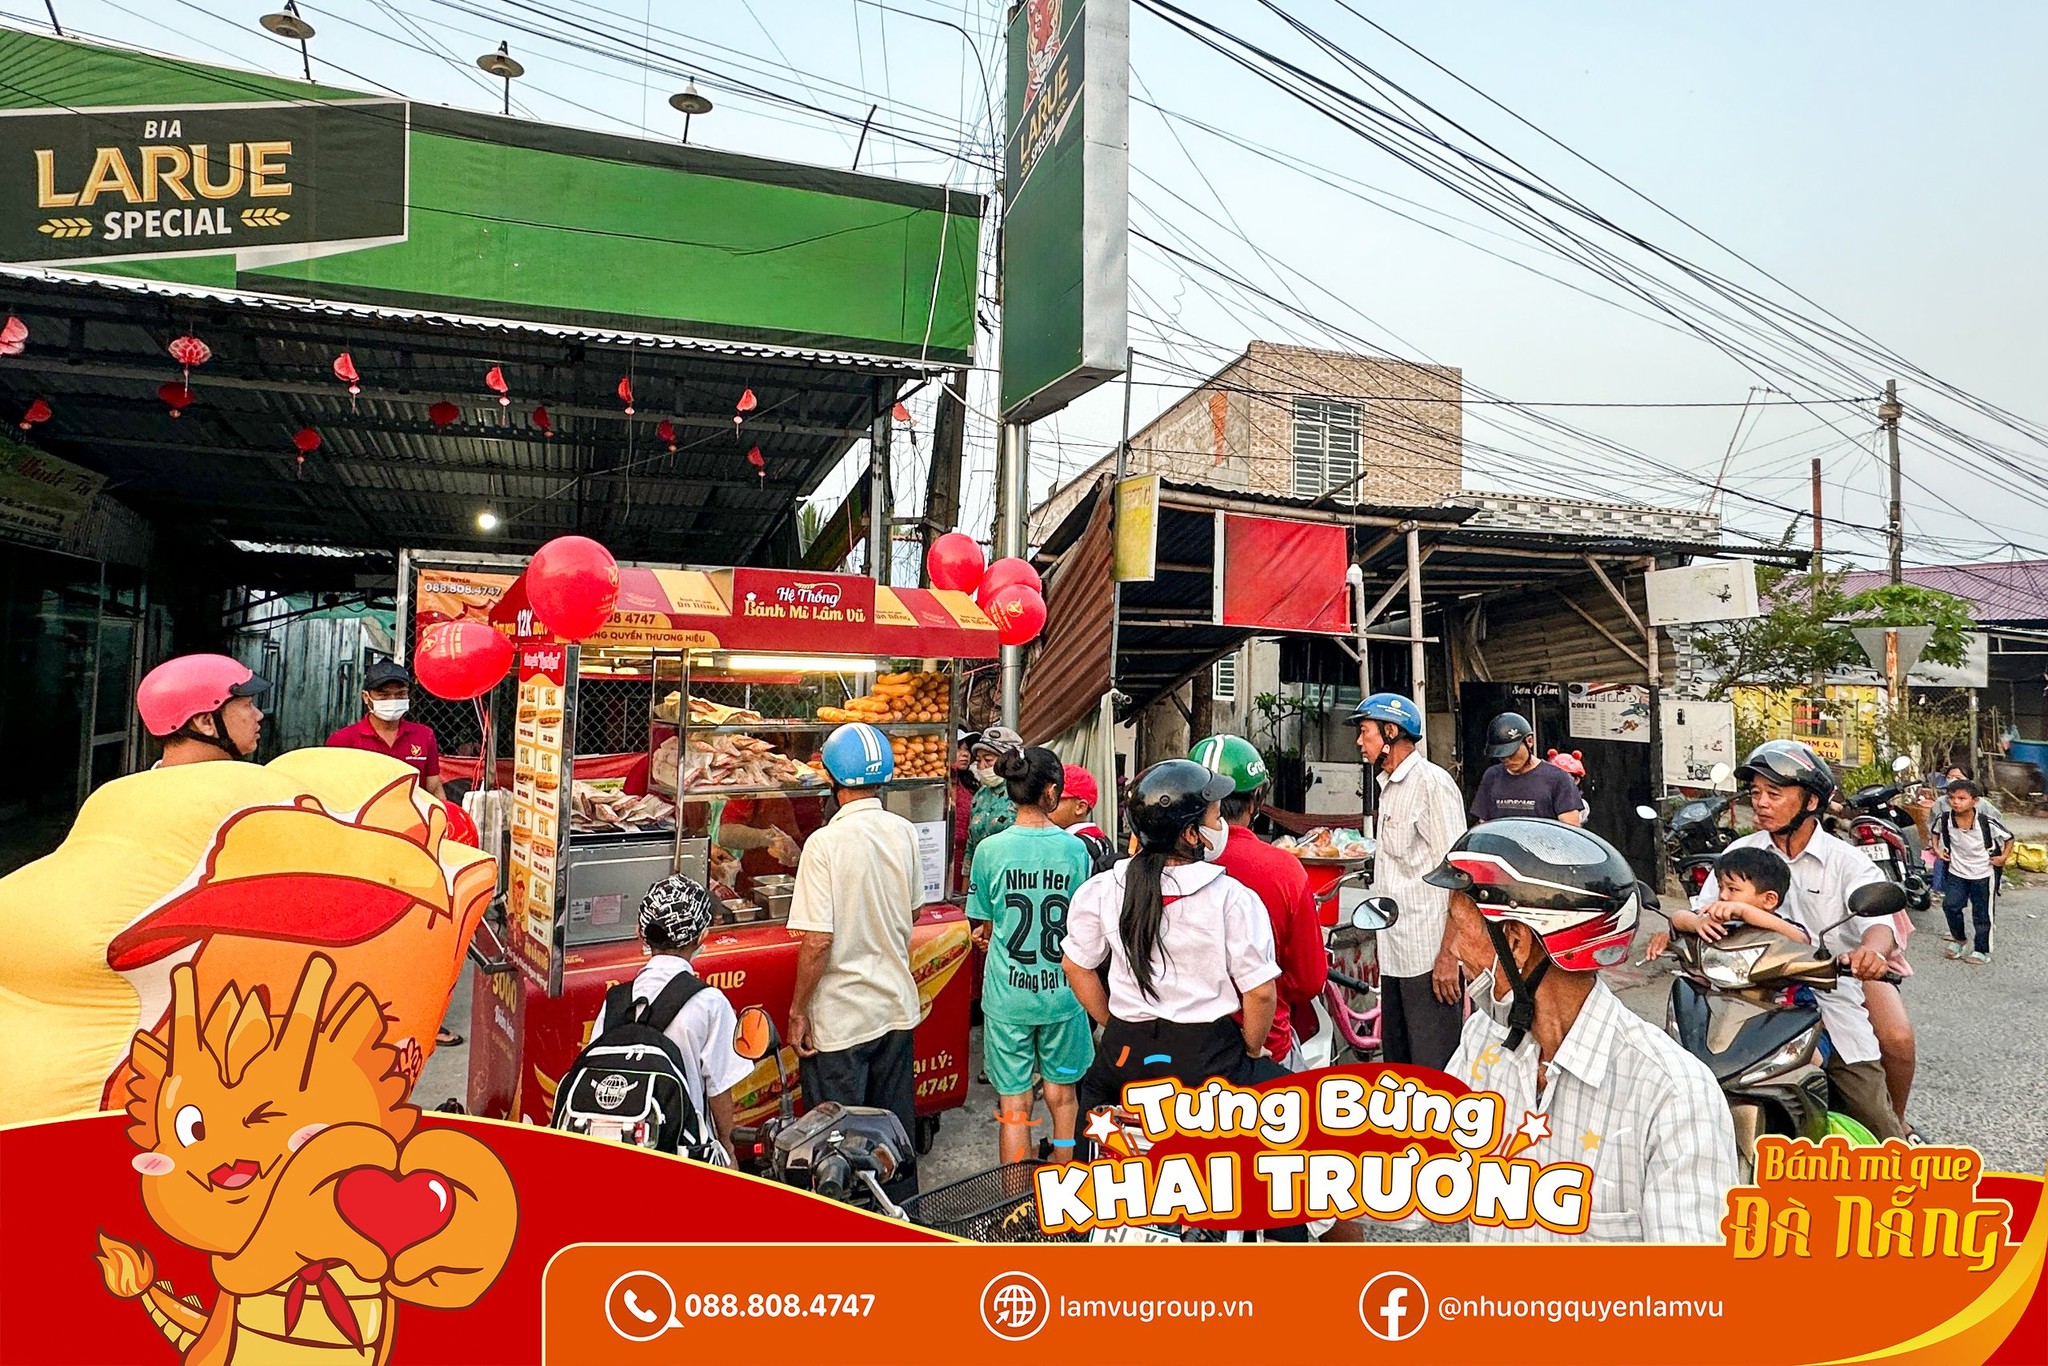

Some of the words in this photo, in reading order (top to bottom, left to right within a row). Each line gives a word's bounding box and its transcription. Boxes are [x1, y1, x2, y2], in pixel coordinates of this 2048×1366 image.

[1020, 53, 1069, 166] LARUE
[144, 119, 182, 138] BIA
[34, 141, 293, 208] LARUE
[104, 207, 232, 240] SPECIAL
[424, 582, 502, 597] 088.808.4747
[776, 587, 796, 603] Hệ
[797, 589, 839, 608] Thống
[625, 613, 656, 625] 4747
[743, 599, 786, 617] Bánh
[789, 605, 809, 619] Mì
[812, 605, 844, 621] Lâm
[846, 608, 866, 623] Vũ
[611, 629, 643, 641] QUYỀN
[645, 632, 684, 642] THƯƠNG
[686, 633, 706, 644] HIỆU
[1005, 868, 1039, 890] Như
[1005, 893, 1071, 966] 28
[1009, 965, 1039, 994] Trang
[1041, 969, 1060, 994] Đại
[912, 1059, 926, 1079] ẠI
[930, 1050, 953, 1072] LÝ:
[916, 1073, 960, 1098] 4747
